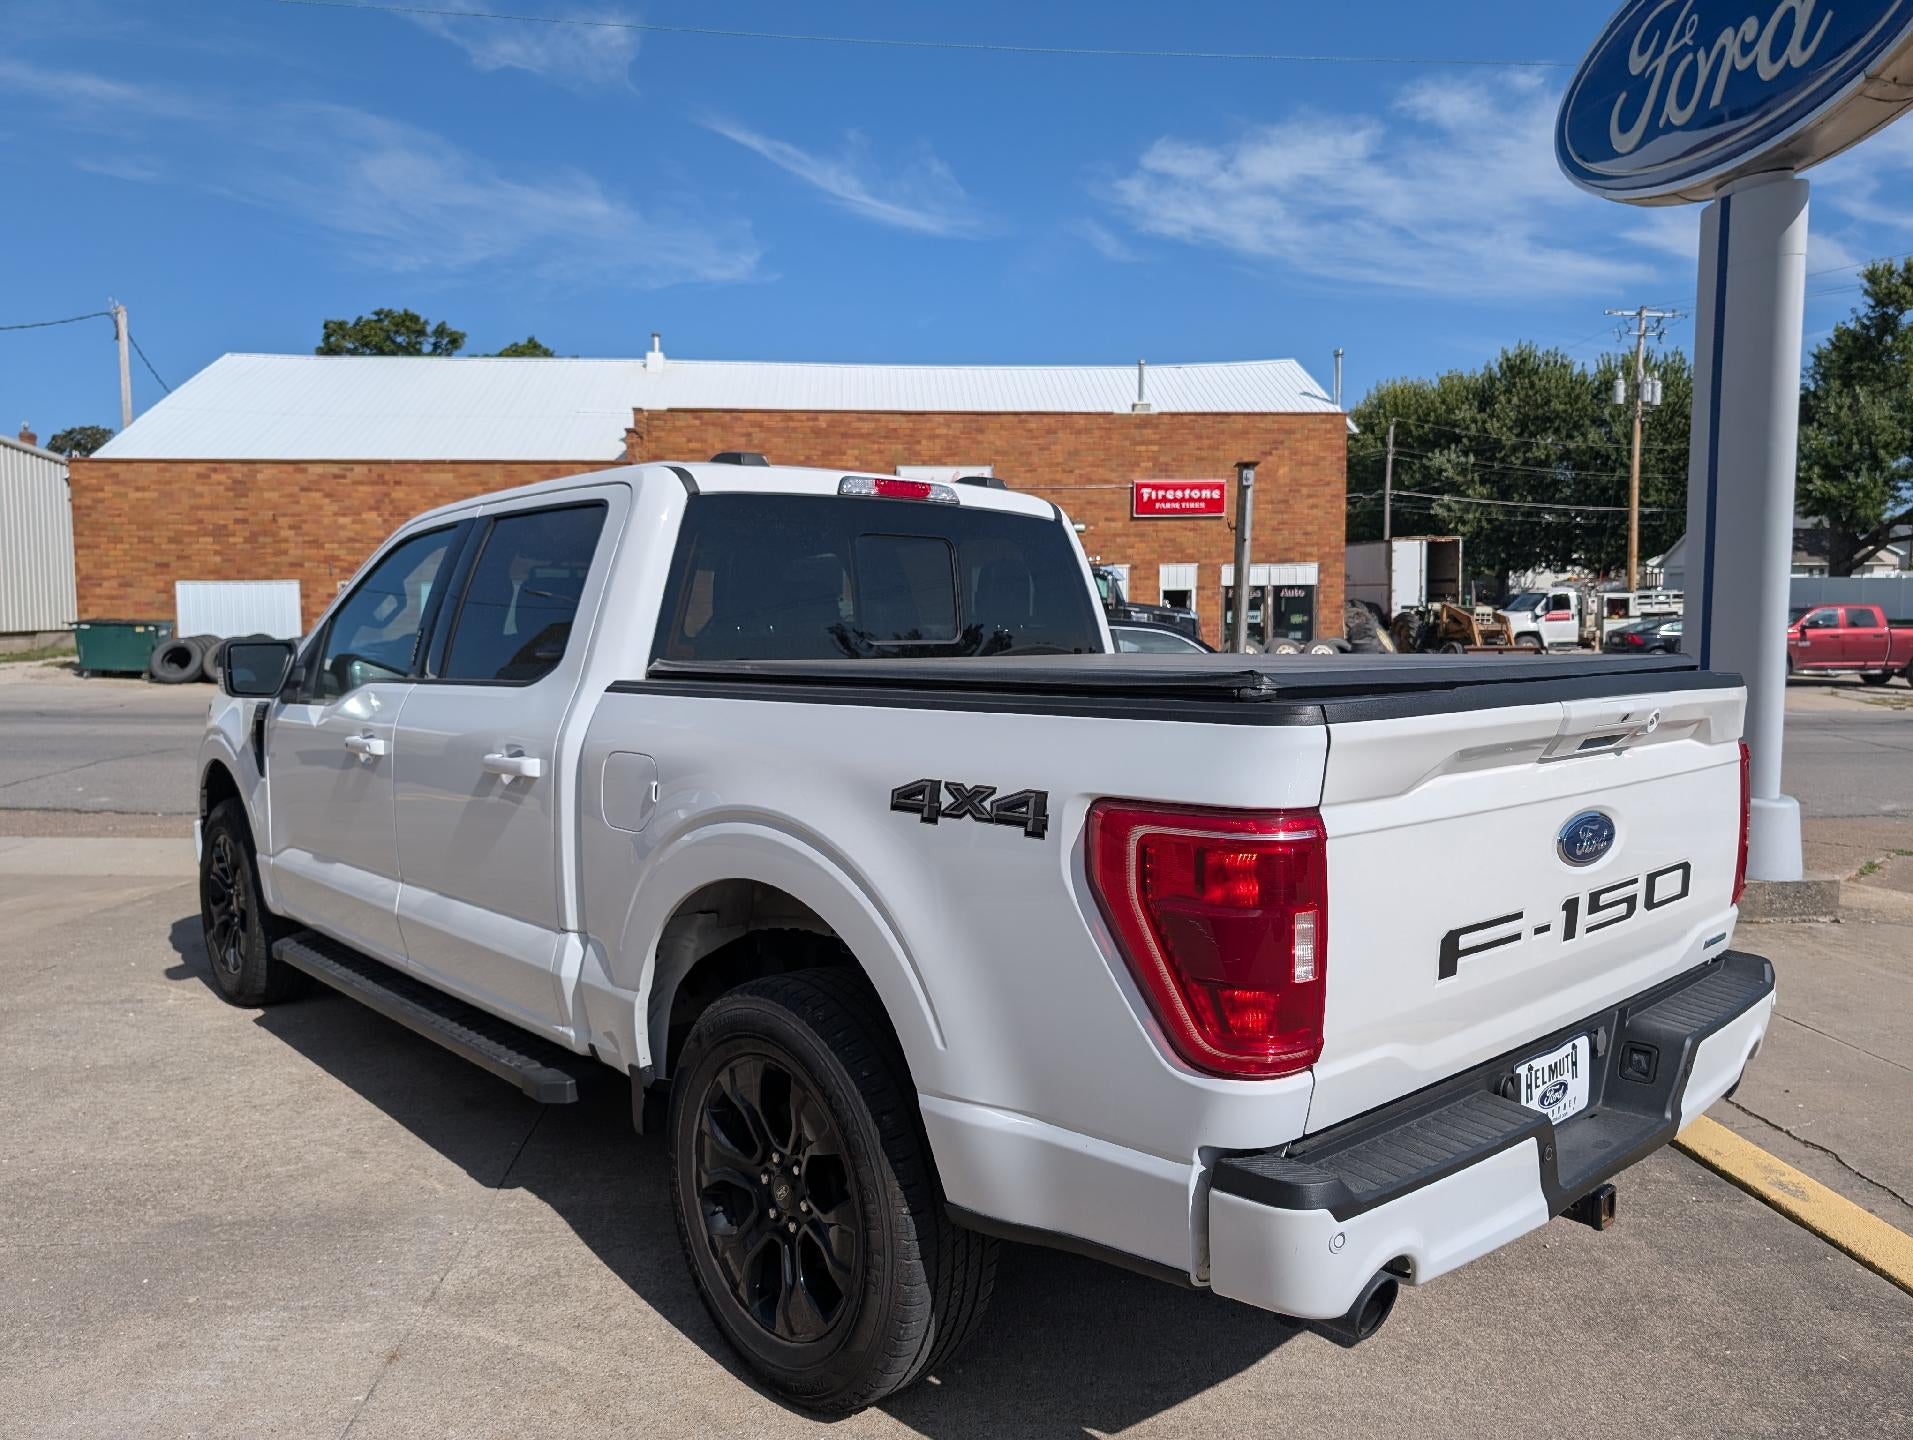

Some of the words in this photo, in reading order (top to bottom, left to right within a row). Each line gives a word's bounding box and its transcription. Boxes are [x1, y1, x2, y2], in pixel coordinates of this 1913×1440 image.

[1609, 0, 1834, 153] Ford
[1140, 488, 1221, 502] Firestone
[1280, 588, 1305, 597] Auto
[1576, 824, 1609, 855] Ford
[1437, 861, 1692, 980] F-150
[1525, 1043, 1578, 1105] HELMUTH
[1543, 1083, 1566, 1106] Ford
